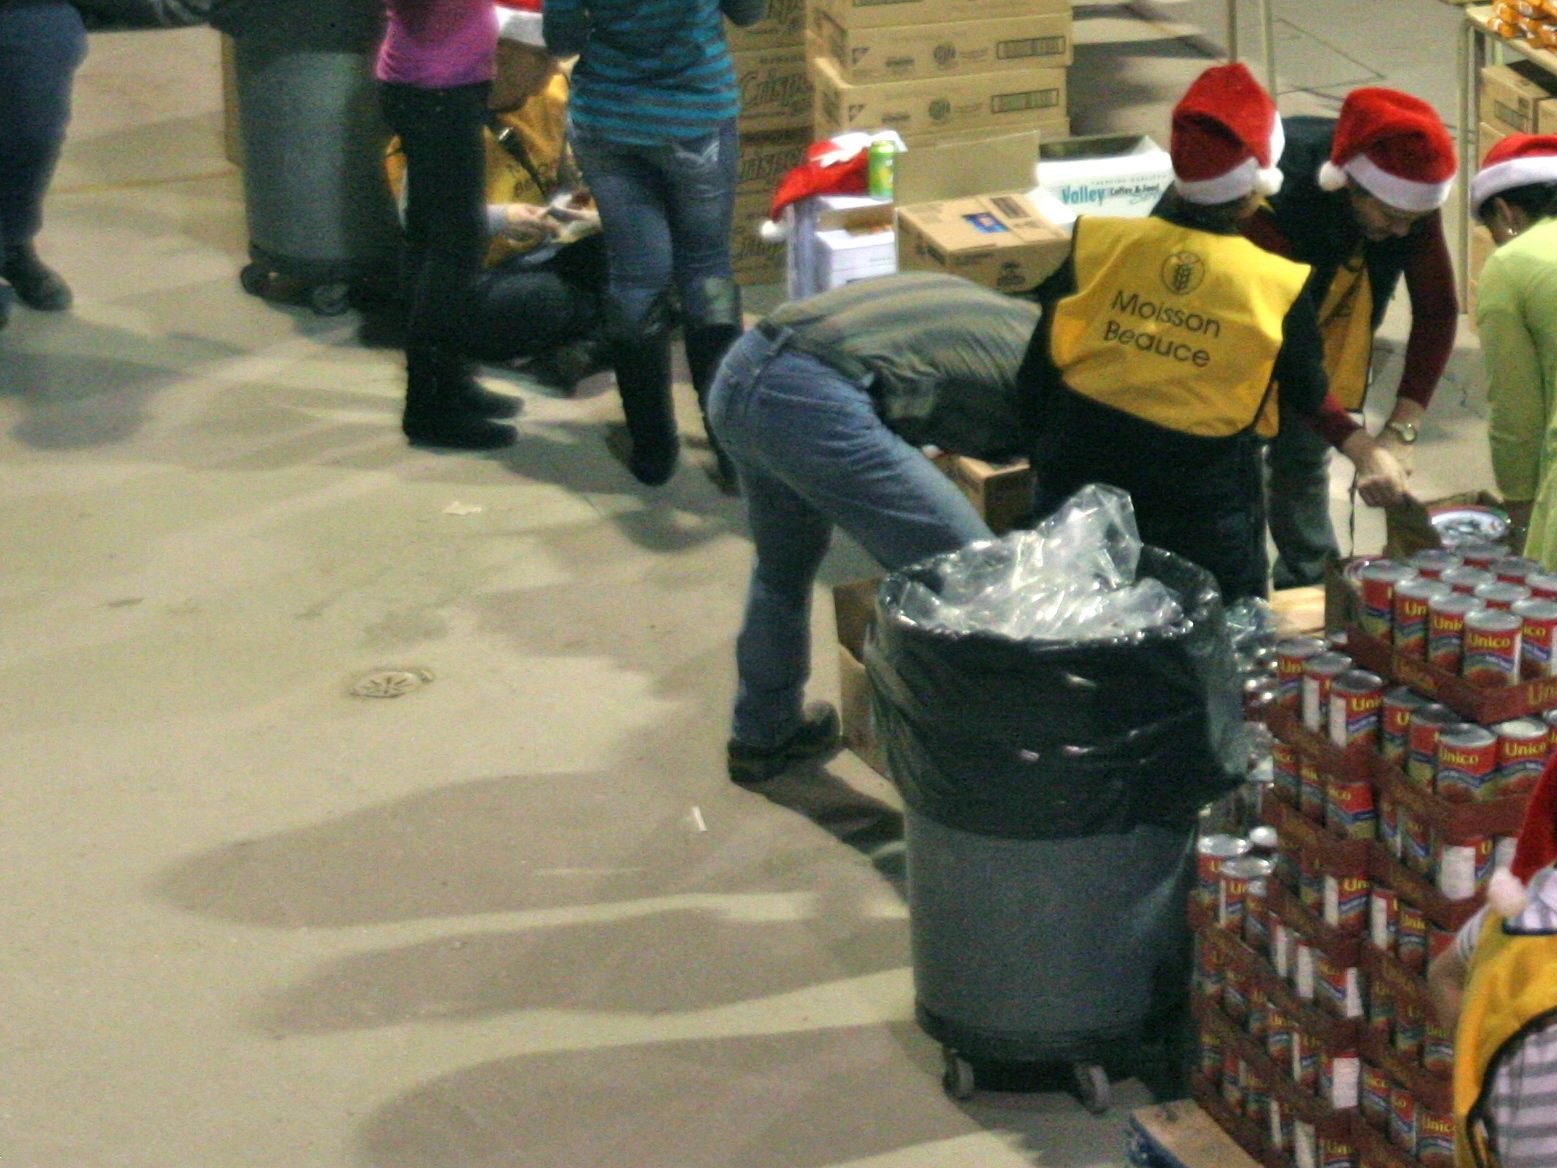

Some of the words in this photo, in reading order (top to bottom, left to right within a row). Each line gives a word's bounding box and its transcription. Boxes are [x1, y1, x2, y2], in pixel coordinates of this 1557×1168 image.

[1061, 184, 1105, 207] Valley
[1110, 289, 1222, 339] Moisson
[1103, 319, 1211, 368] Beauce
[1467, 631, 1511, 649] Unico
[1438, 746, 1479, 766] Unico
[1504, 741, 1547, 758] Unico
